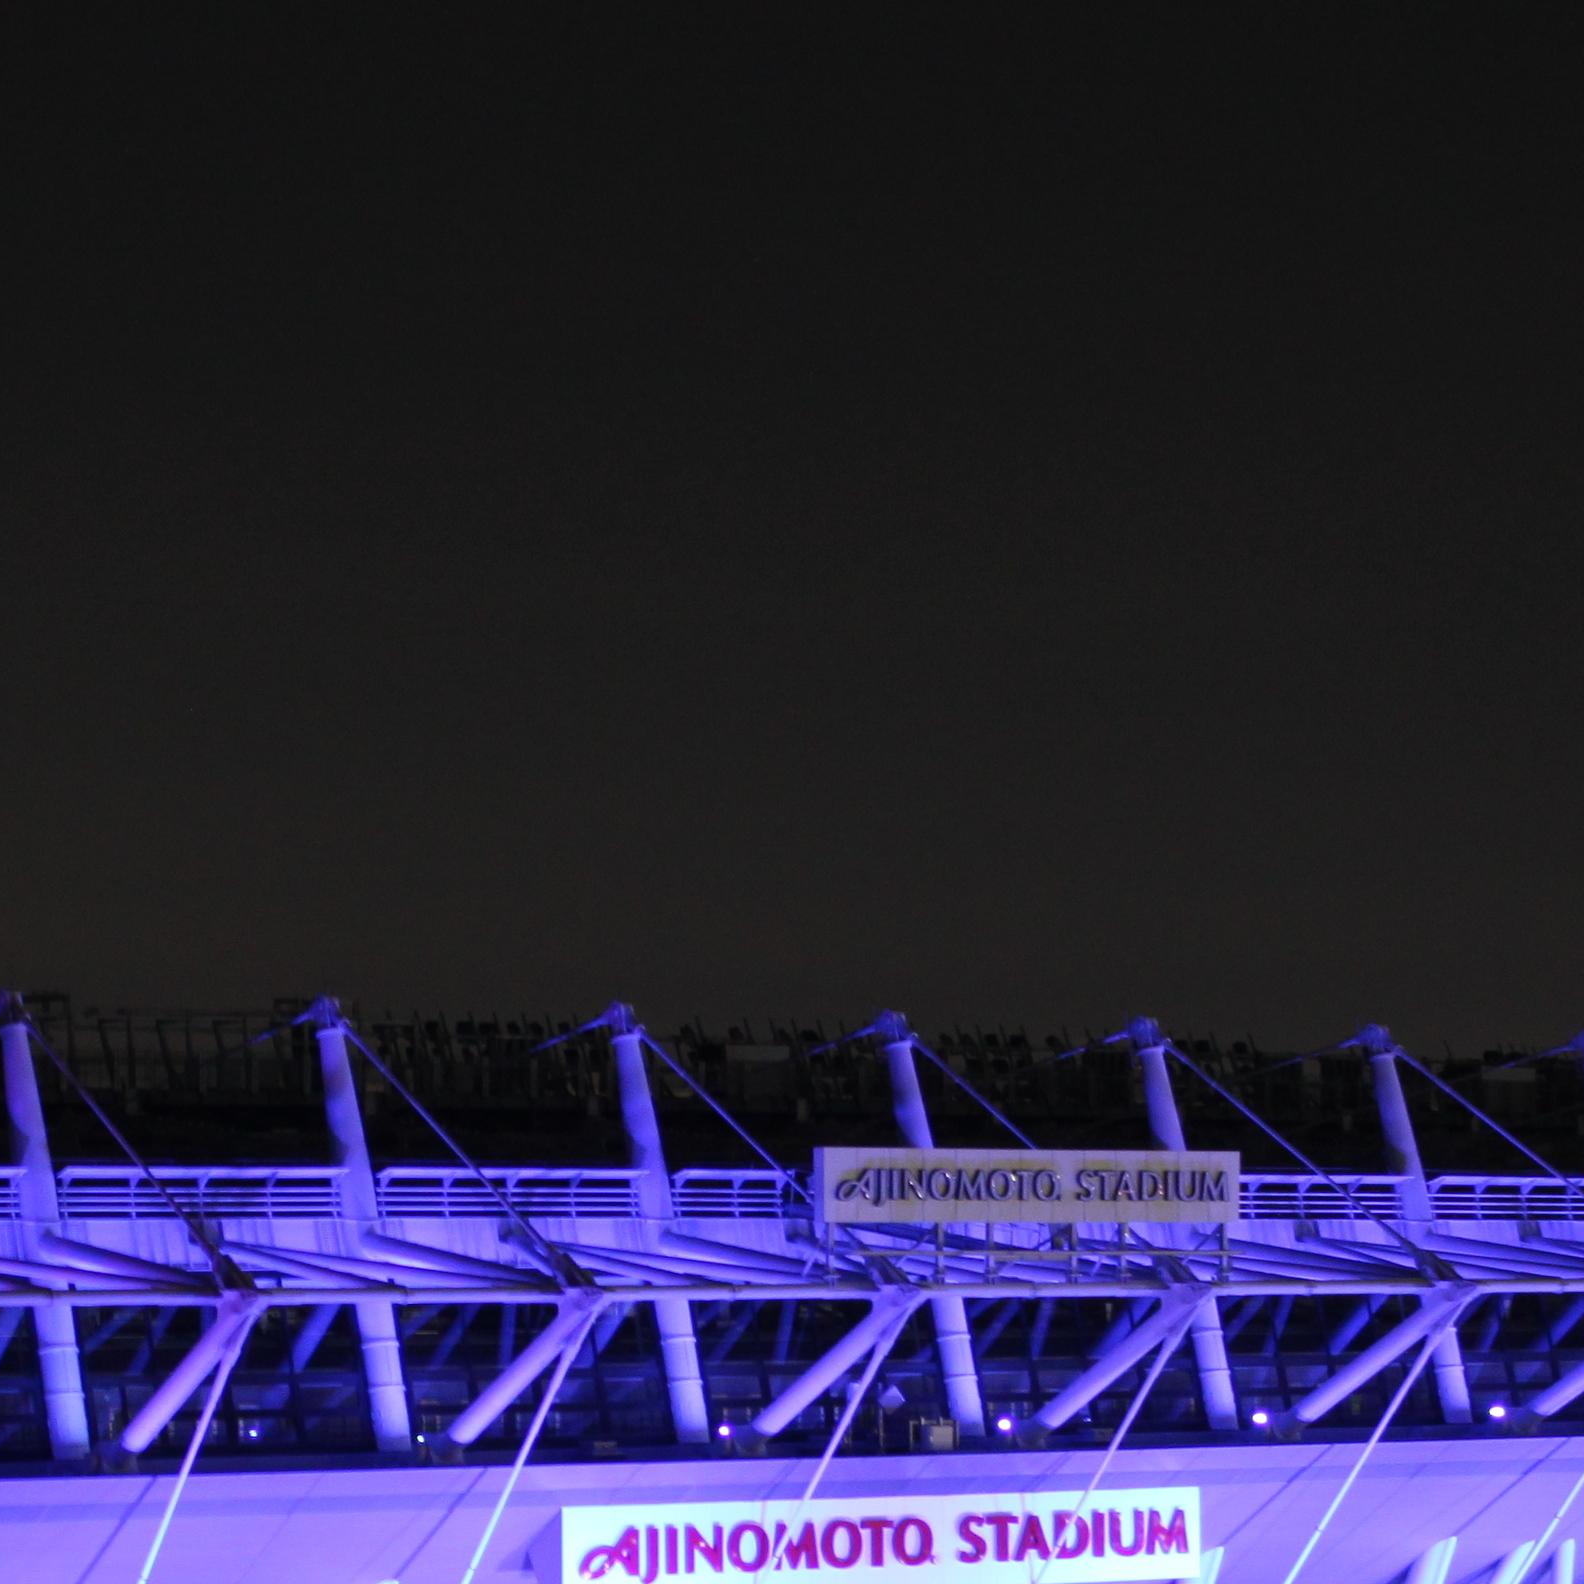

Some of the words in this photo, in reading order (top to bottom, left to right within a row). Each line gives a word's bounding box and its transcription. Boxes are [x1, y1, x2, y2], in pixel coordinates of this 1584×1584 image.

[835, 1167, 1061, 1207] AJINOMOTO
[1075, 1168, 1231, 1202] STADIUM
[954, 1506, 1190, 1564] STADIUM
